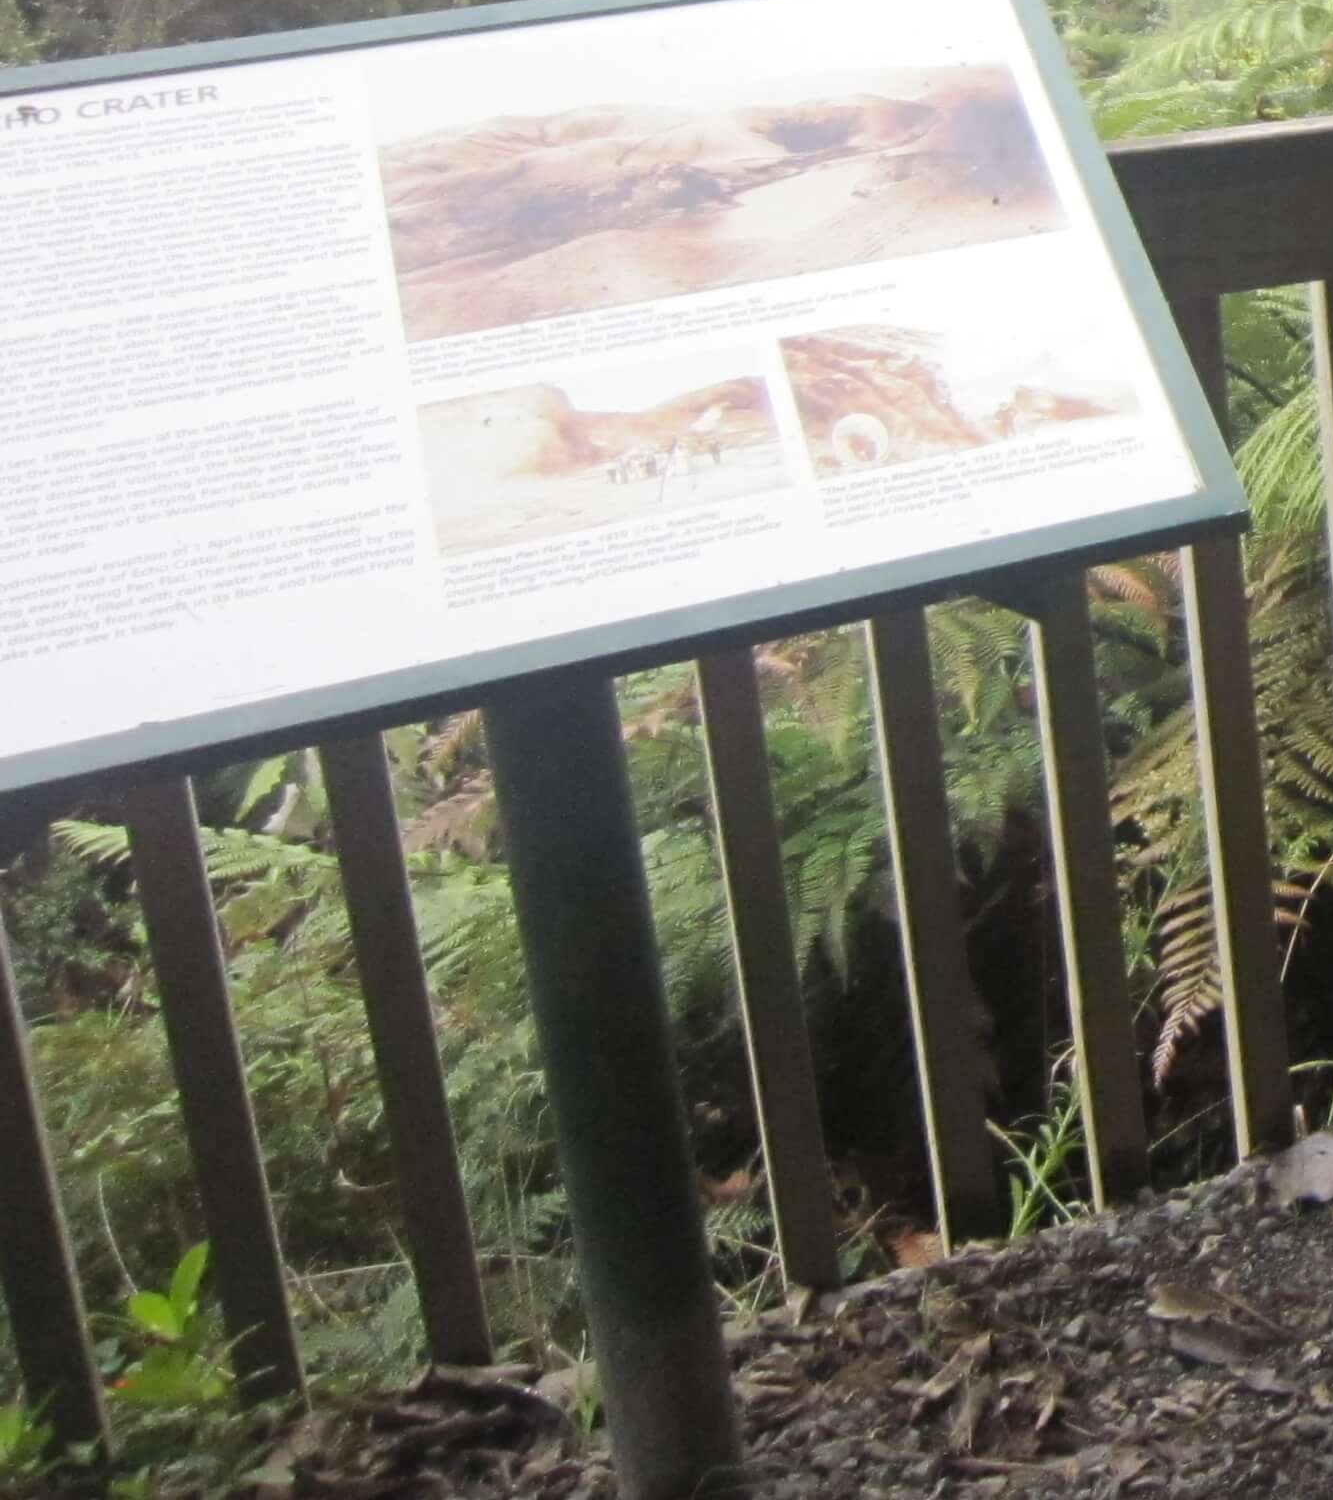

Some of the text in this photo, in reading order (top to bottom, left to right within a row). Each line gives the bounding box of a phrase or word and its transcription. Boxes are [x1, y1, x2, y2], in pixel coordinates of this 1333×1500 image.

[0, 85, 219, 130] HO CRATER
[0, 562, 98, 593] ydrothermal
[0, 647, 29, 663] ake
